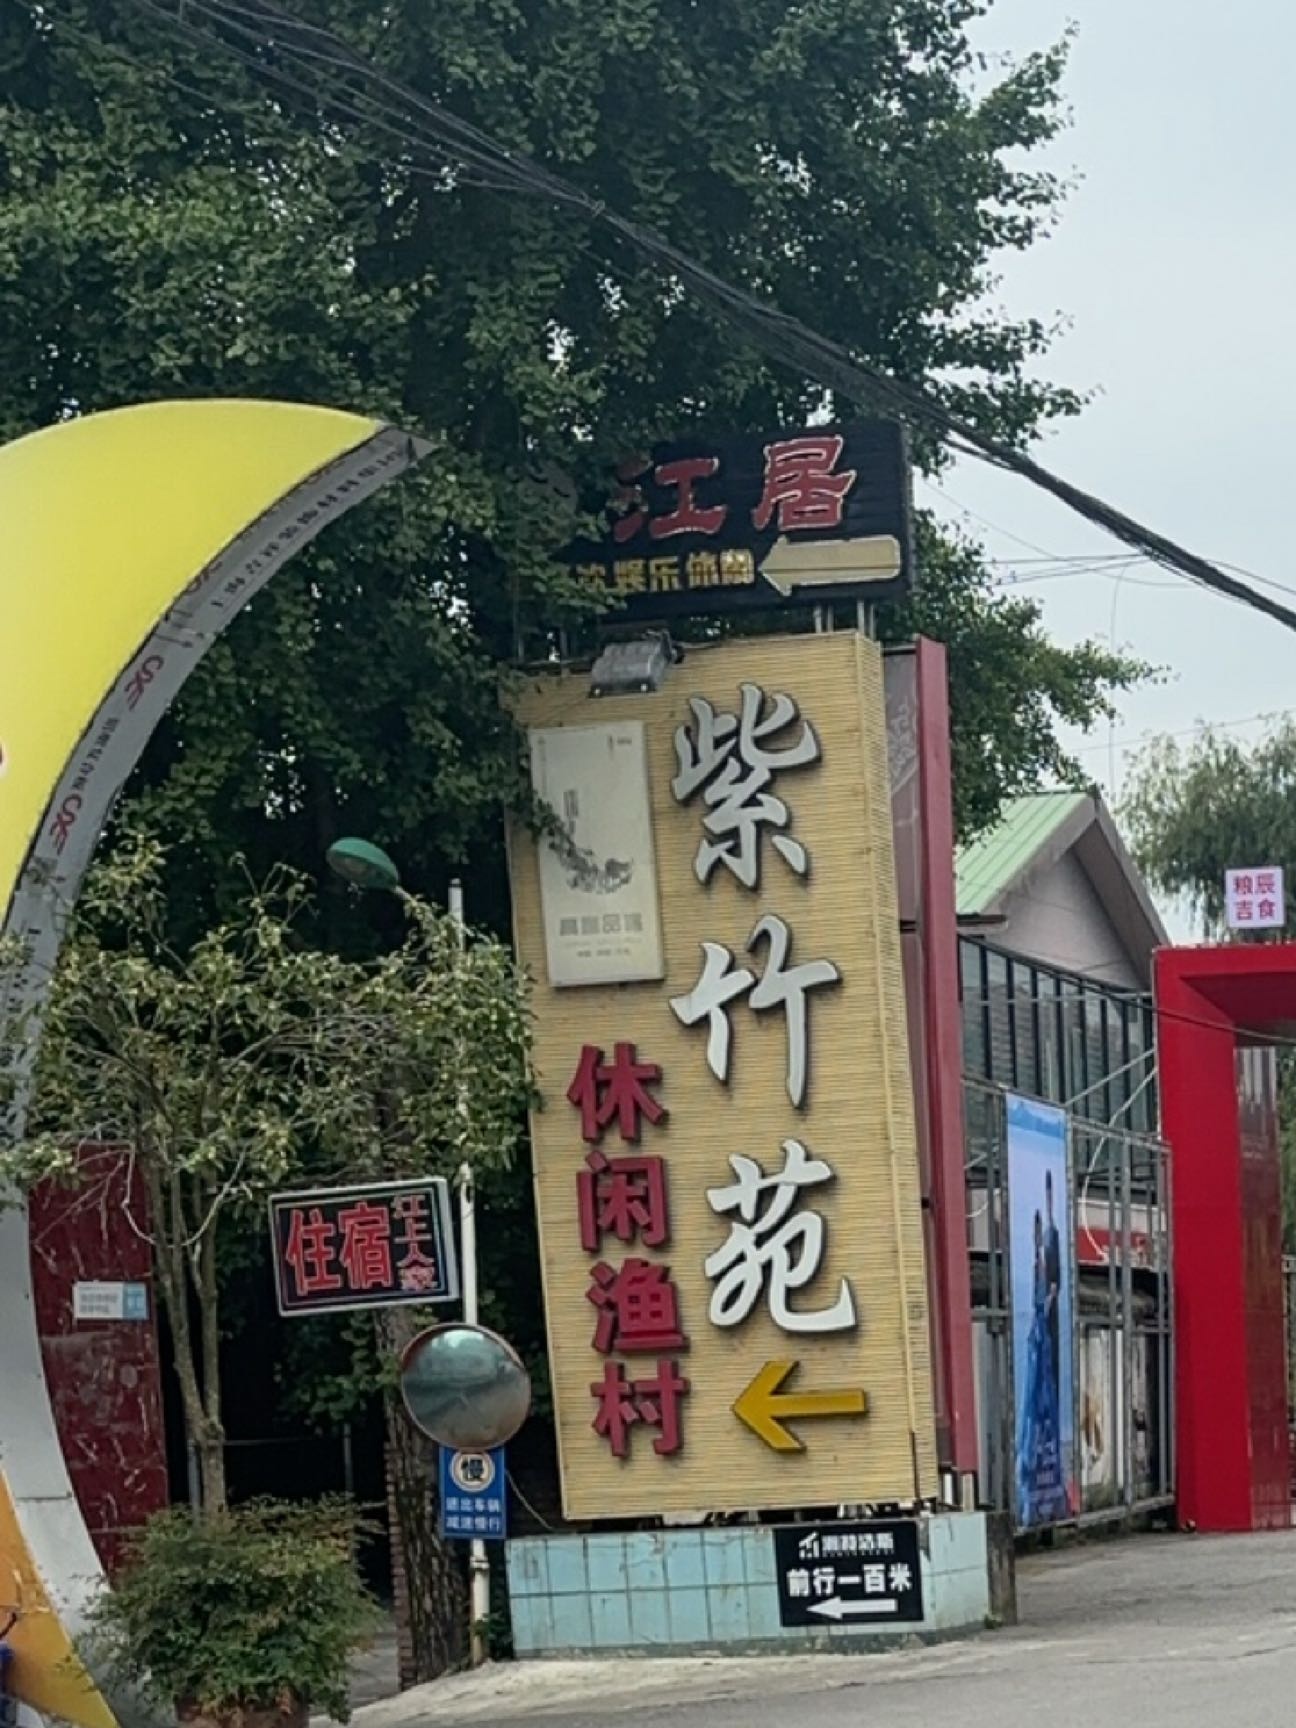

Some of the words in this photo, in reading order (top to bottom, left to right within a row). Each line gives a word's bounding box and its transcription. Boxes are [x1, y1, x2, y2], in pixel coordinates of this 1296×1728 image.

[668, 682, 858, 1334] 紫竹苑
[286, 1202, 393, 1297] 住宿
[566, 1041, 690, 1459] 休闲渔村
[786, 1563, 913, 1597] 前行一百米
